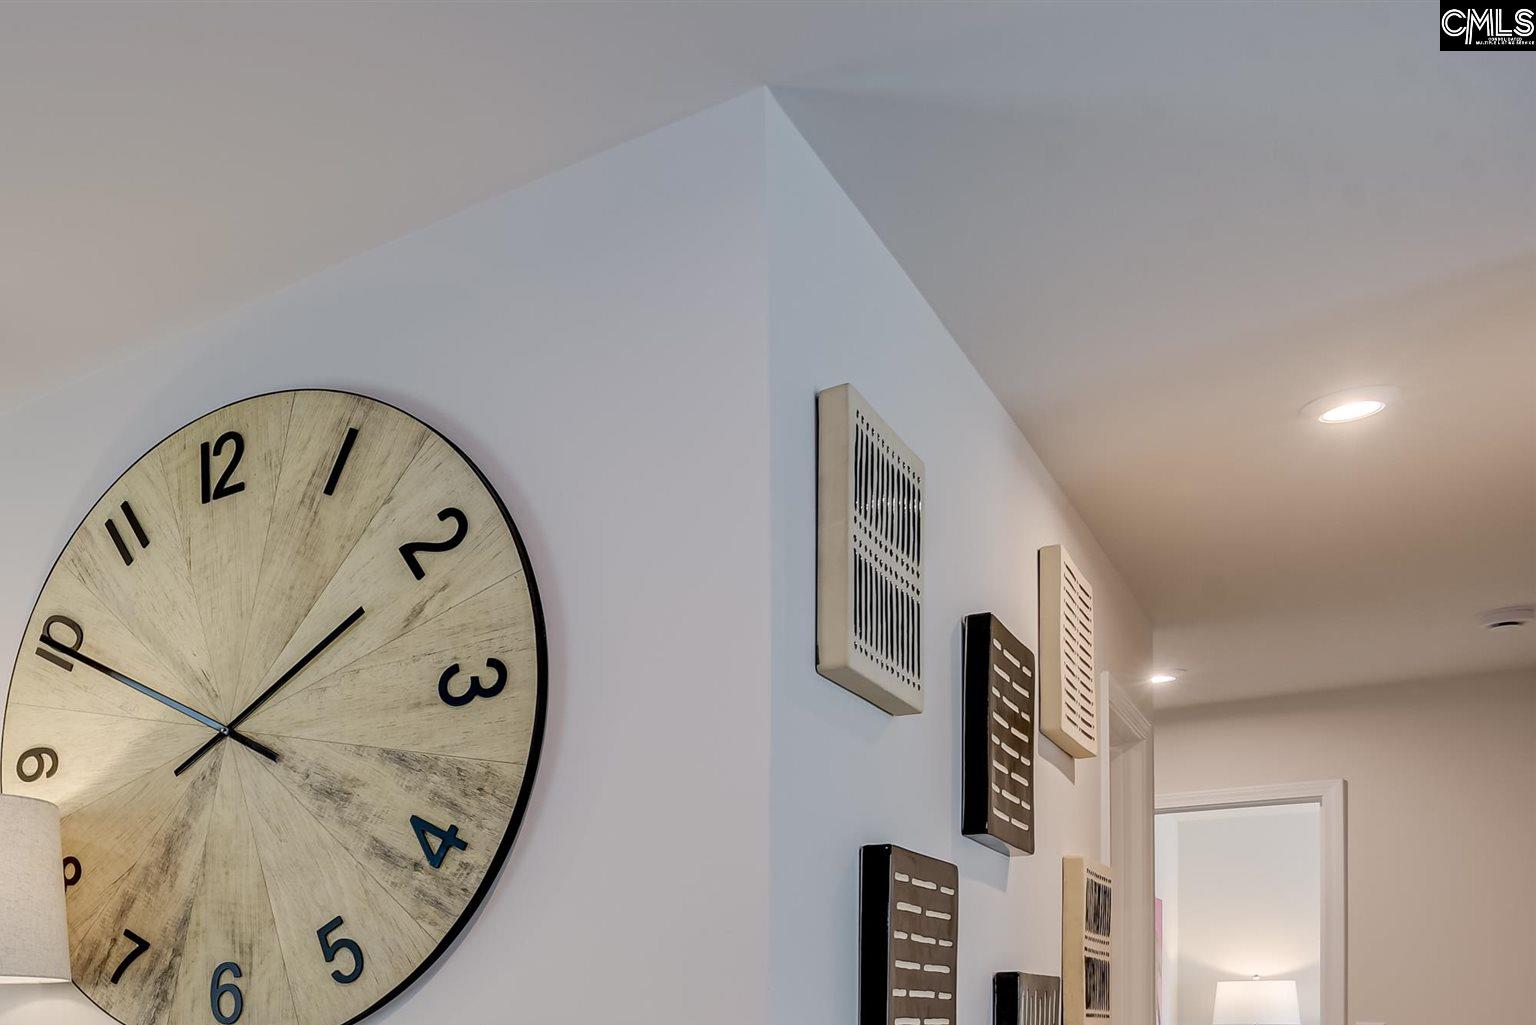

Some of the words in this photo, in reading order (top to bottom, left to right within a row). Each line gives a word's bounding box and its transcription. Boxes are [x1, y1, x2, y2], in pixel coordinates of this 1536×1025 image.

[199, 430, 246, 505] 12
[104, 500, 151, 567] 11
[398, 507, 469, 581] 2
[437, 657, 508, 708] 3
[16, 746, 59, 783] 9
[409, 814, 470, 870] 4
[109, 928, 151, 985] 7
[316, 915, 365, 985] 5
[209, 961, 245, 1025] 6
